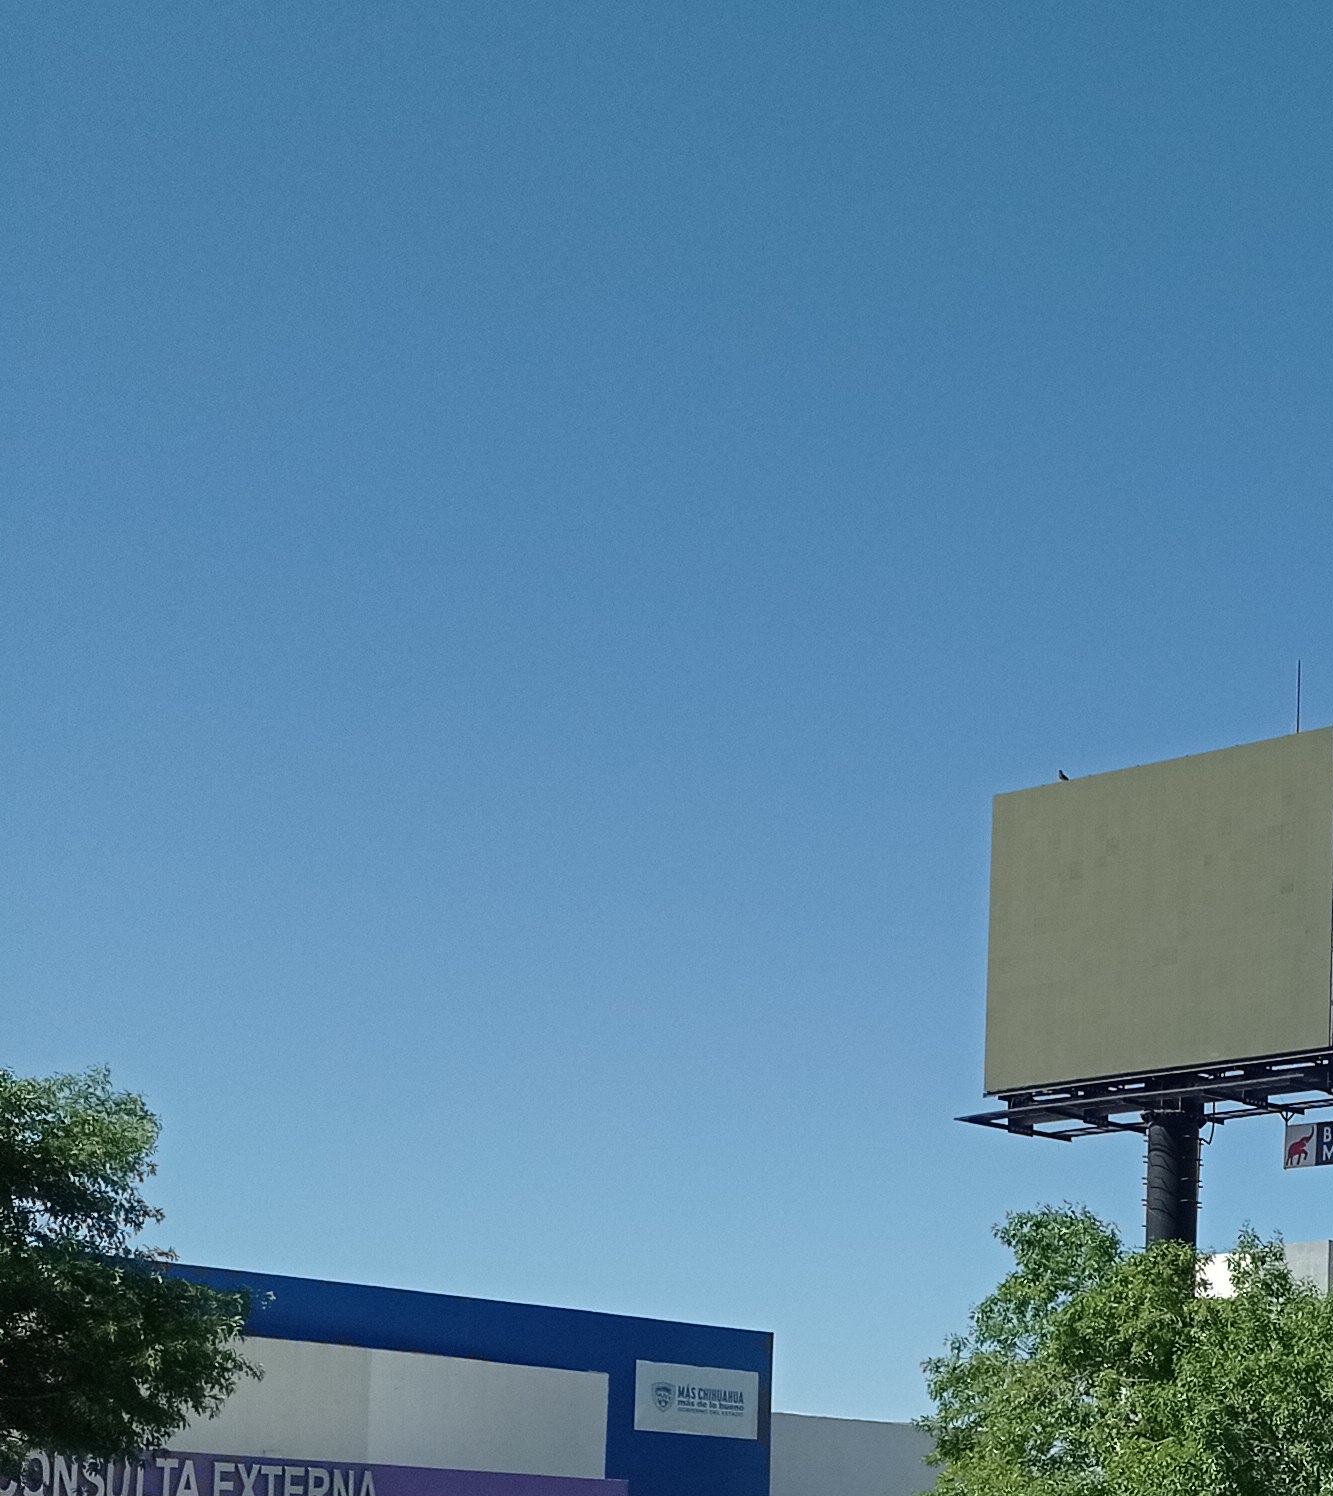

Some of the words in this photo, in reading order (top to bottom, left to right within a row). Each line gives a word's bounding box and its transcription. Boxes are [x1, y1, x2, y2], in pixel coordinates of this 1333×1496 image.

[677, 1384, 696, 1400] MÁS
[697, 1387, 744, 1405] CHIHUAHUA
[696, 1401, 708, 1409] de
[709, 1401, 718, 1410] lo
[719, 1403, 745, 1412] bueno
